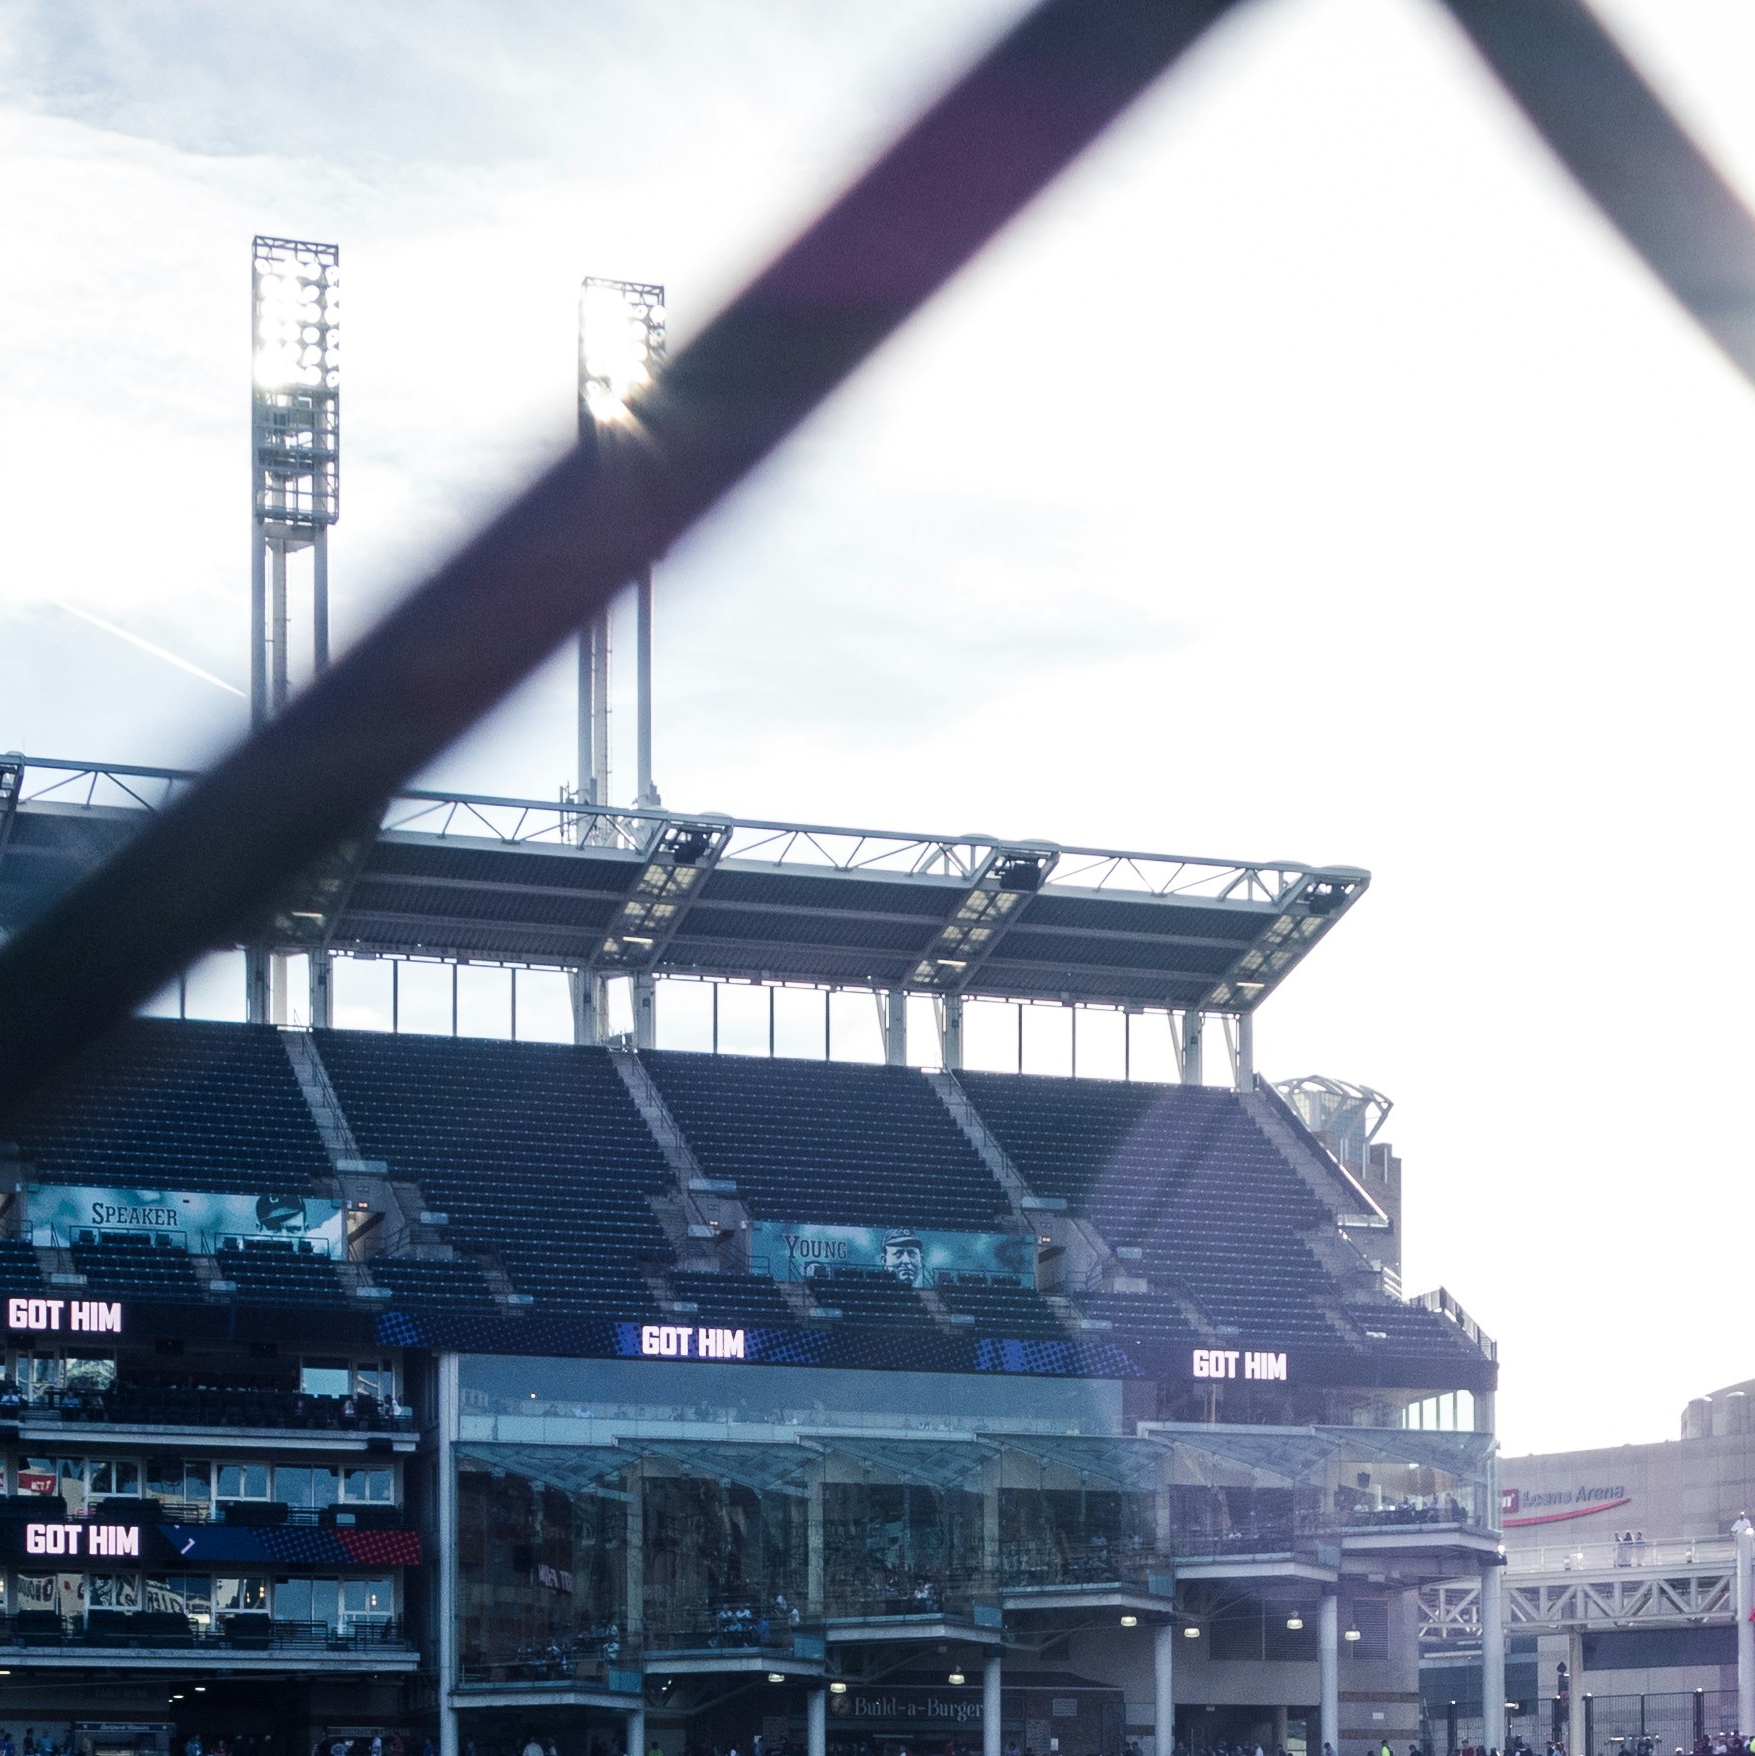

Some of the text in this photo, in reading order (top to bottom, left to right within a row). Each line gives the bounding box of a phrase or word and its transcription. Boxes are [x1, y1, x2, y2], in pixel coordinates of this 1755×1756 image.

[92, 1202, 178, 1227] SPEAKER
[783, 1233, 847, 1261] YOUNG
[9, 1298, 122, 1333] GOT HIM
[642, 1325, 745, 1359] GOT HIM
[1193, 1349, 1287, 1381] GOT HIM
[1576, 1485, 1625, 1503] Arena
[26, 1523, 139, 1556] GOT HIM
[855, 1696, 984, 1722] Build-a-Burger
